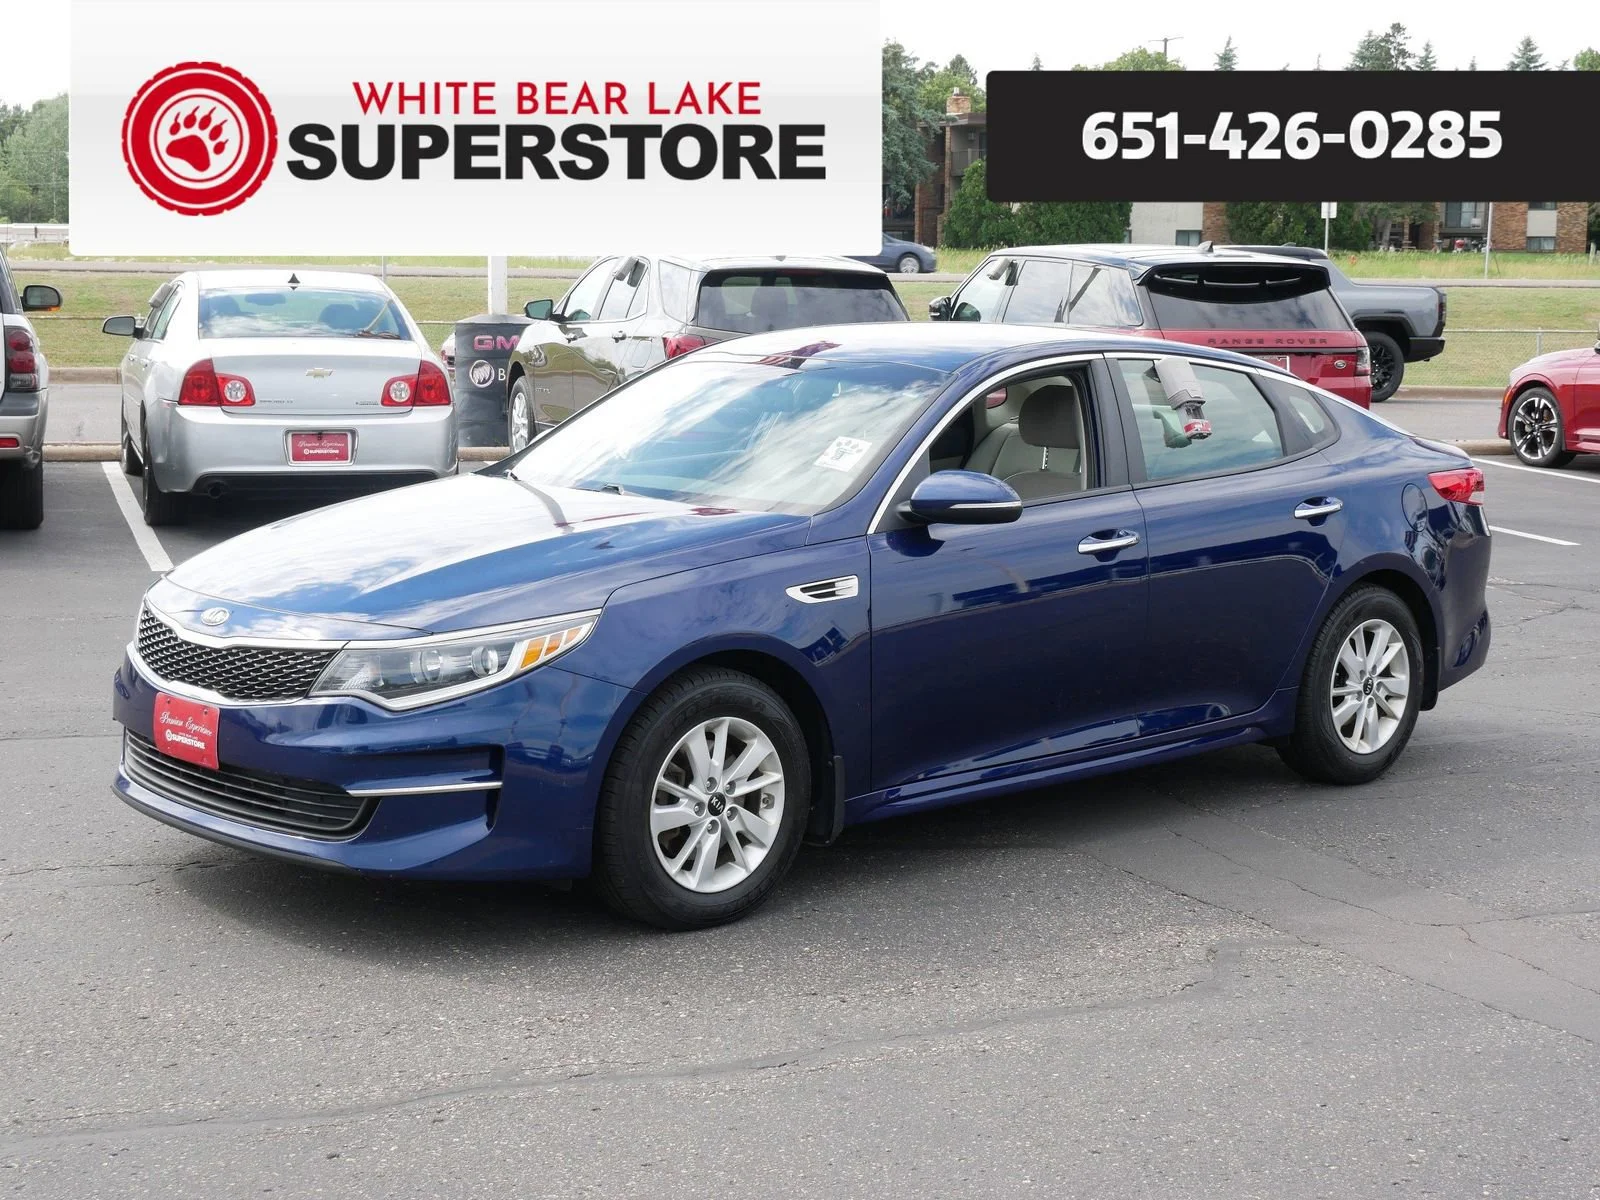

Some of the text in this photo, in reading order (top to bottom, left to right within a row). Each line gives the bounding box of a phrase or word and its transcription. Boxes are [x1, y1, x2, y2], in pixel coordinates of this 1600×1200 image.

[474, 335, 520, 350] GM
[171, 734, 205, 749] SUPERSTORE
[711, 796, 723, 813] KIA
